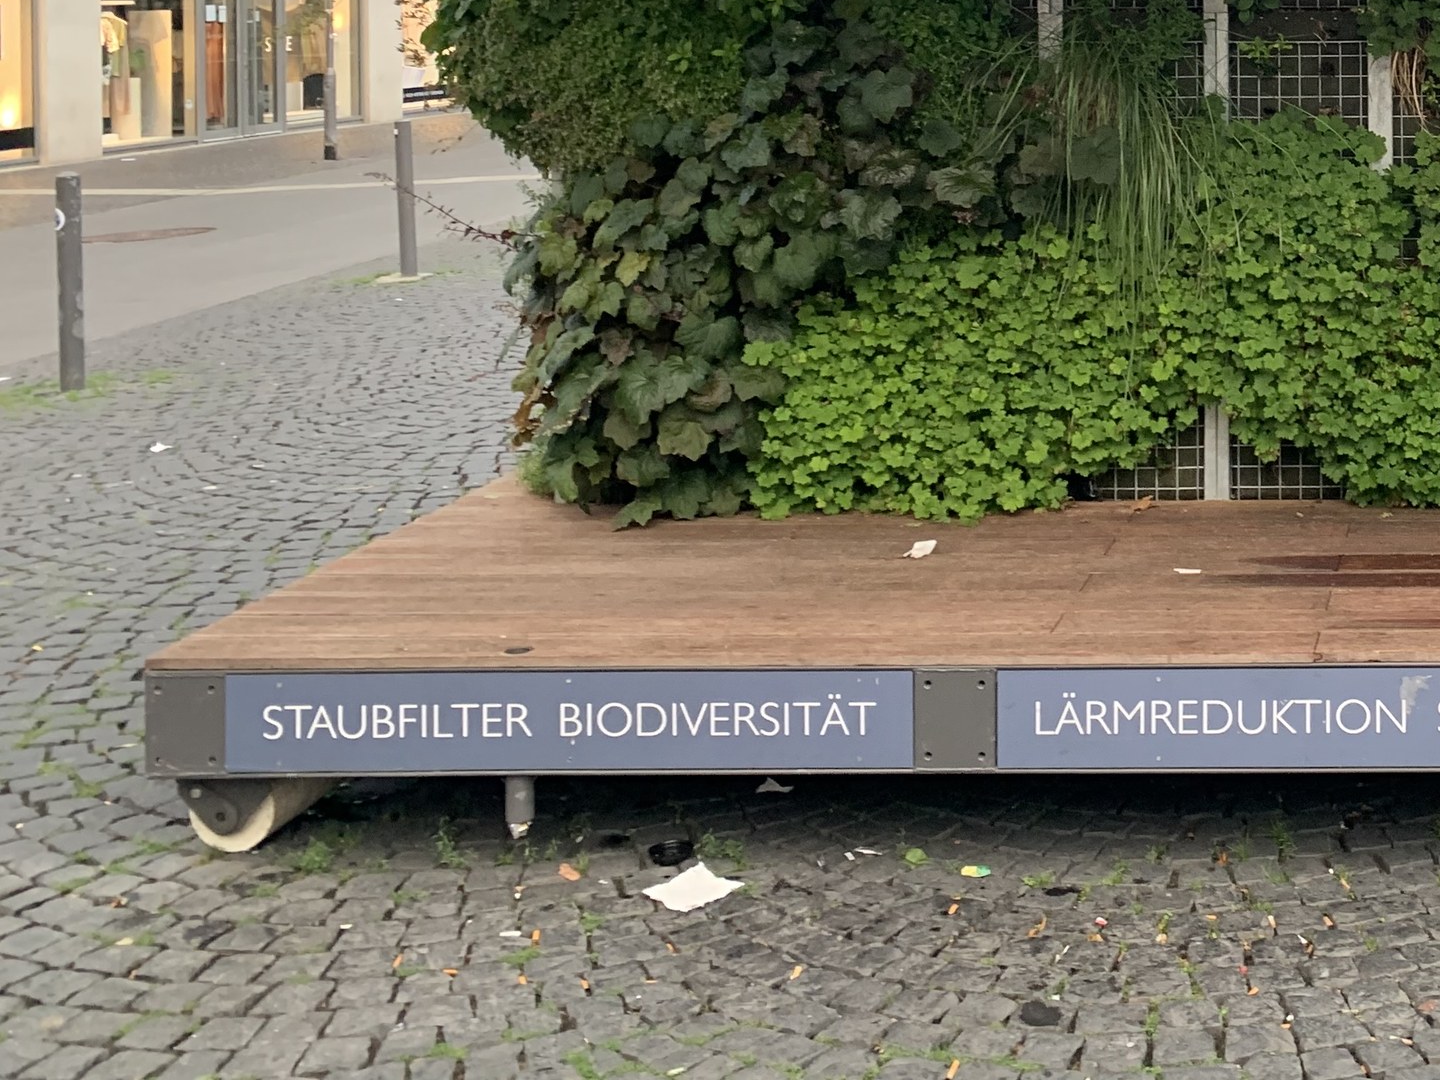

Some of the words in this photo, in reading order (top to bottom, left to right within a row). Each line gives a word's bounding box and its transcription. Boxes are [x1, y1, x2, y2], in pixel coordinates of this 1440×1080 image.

[264, 35, 293, 53] SE
[263, 704, 532, 739] STAUBFILTER
[560, 694, 876, 736] BIODIVERSITÄT
[1036, 692, 1406, 734] LÄRMREDUKTION
